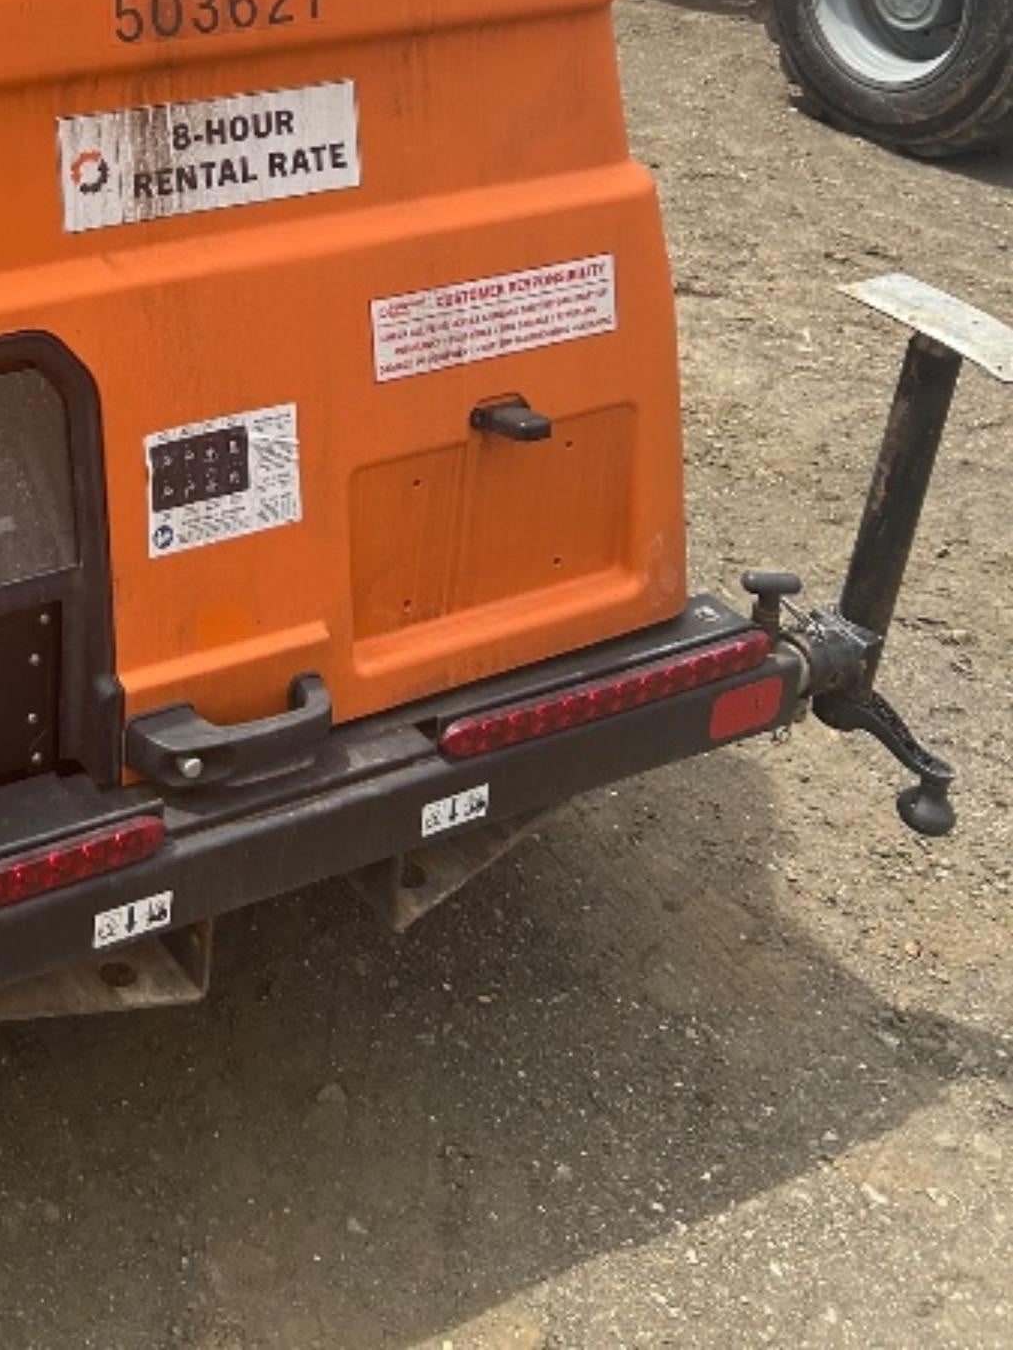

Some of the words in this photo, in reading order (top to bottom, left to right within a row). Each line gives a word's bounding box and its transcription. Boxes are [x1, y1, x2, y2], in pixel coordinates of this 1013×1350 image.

[172, 109, 295, 151] 8-HOUR
[133, 157, 258, 200] RENTAL
[267, 142, 349, 179] RATE
